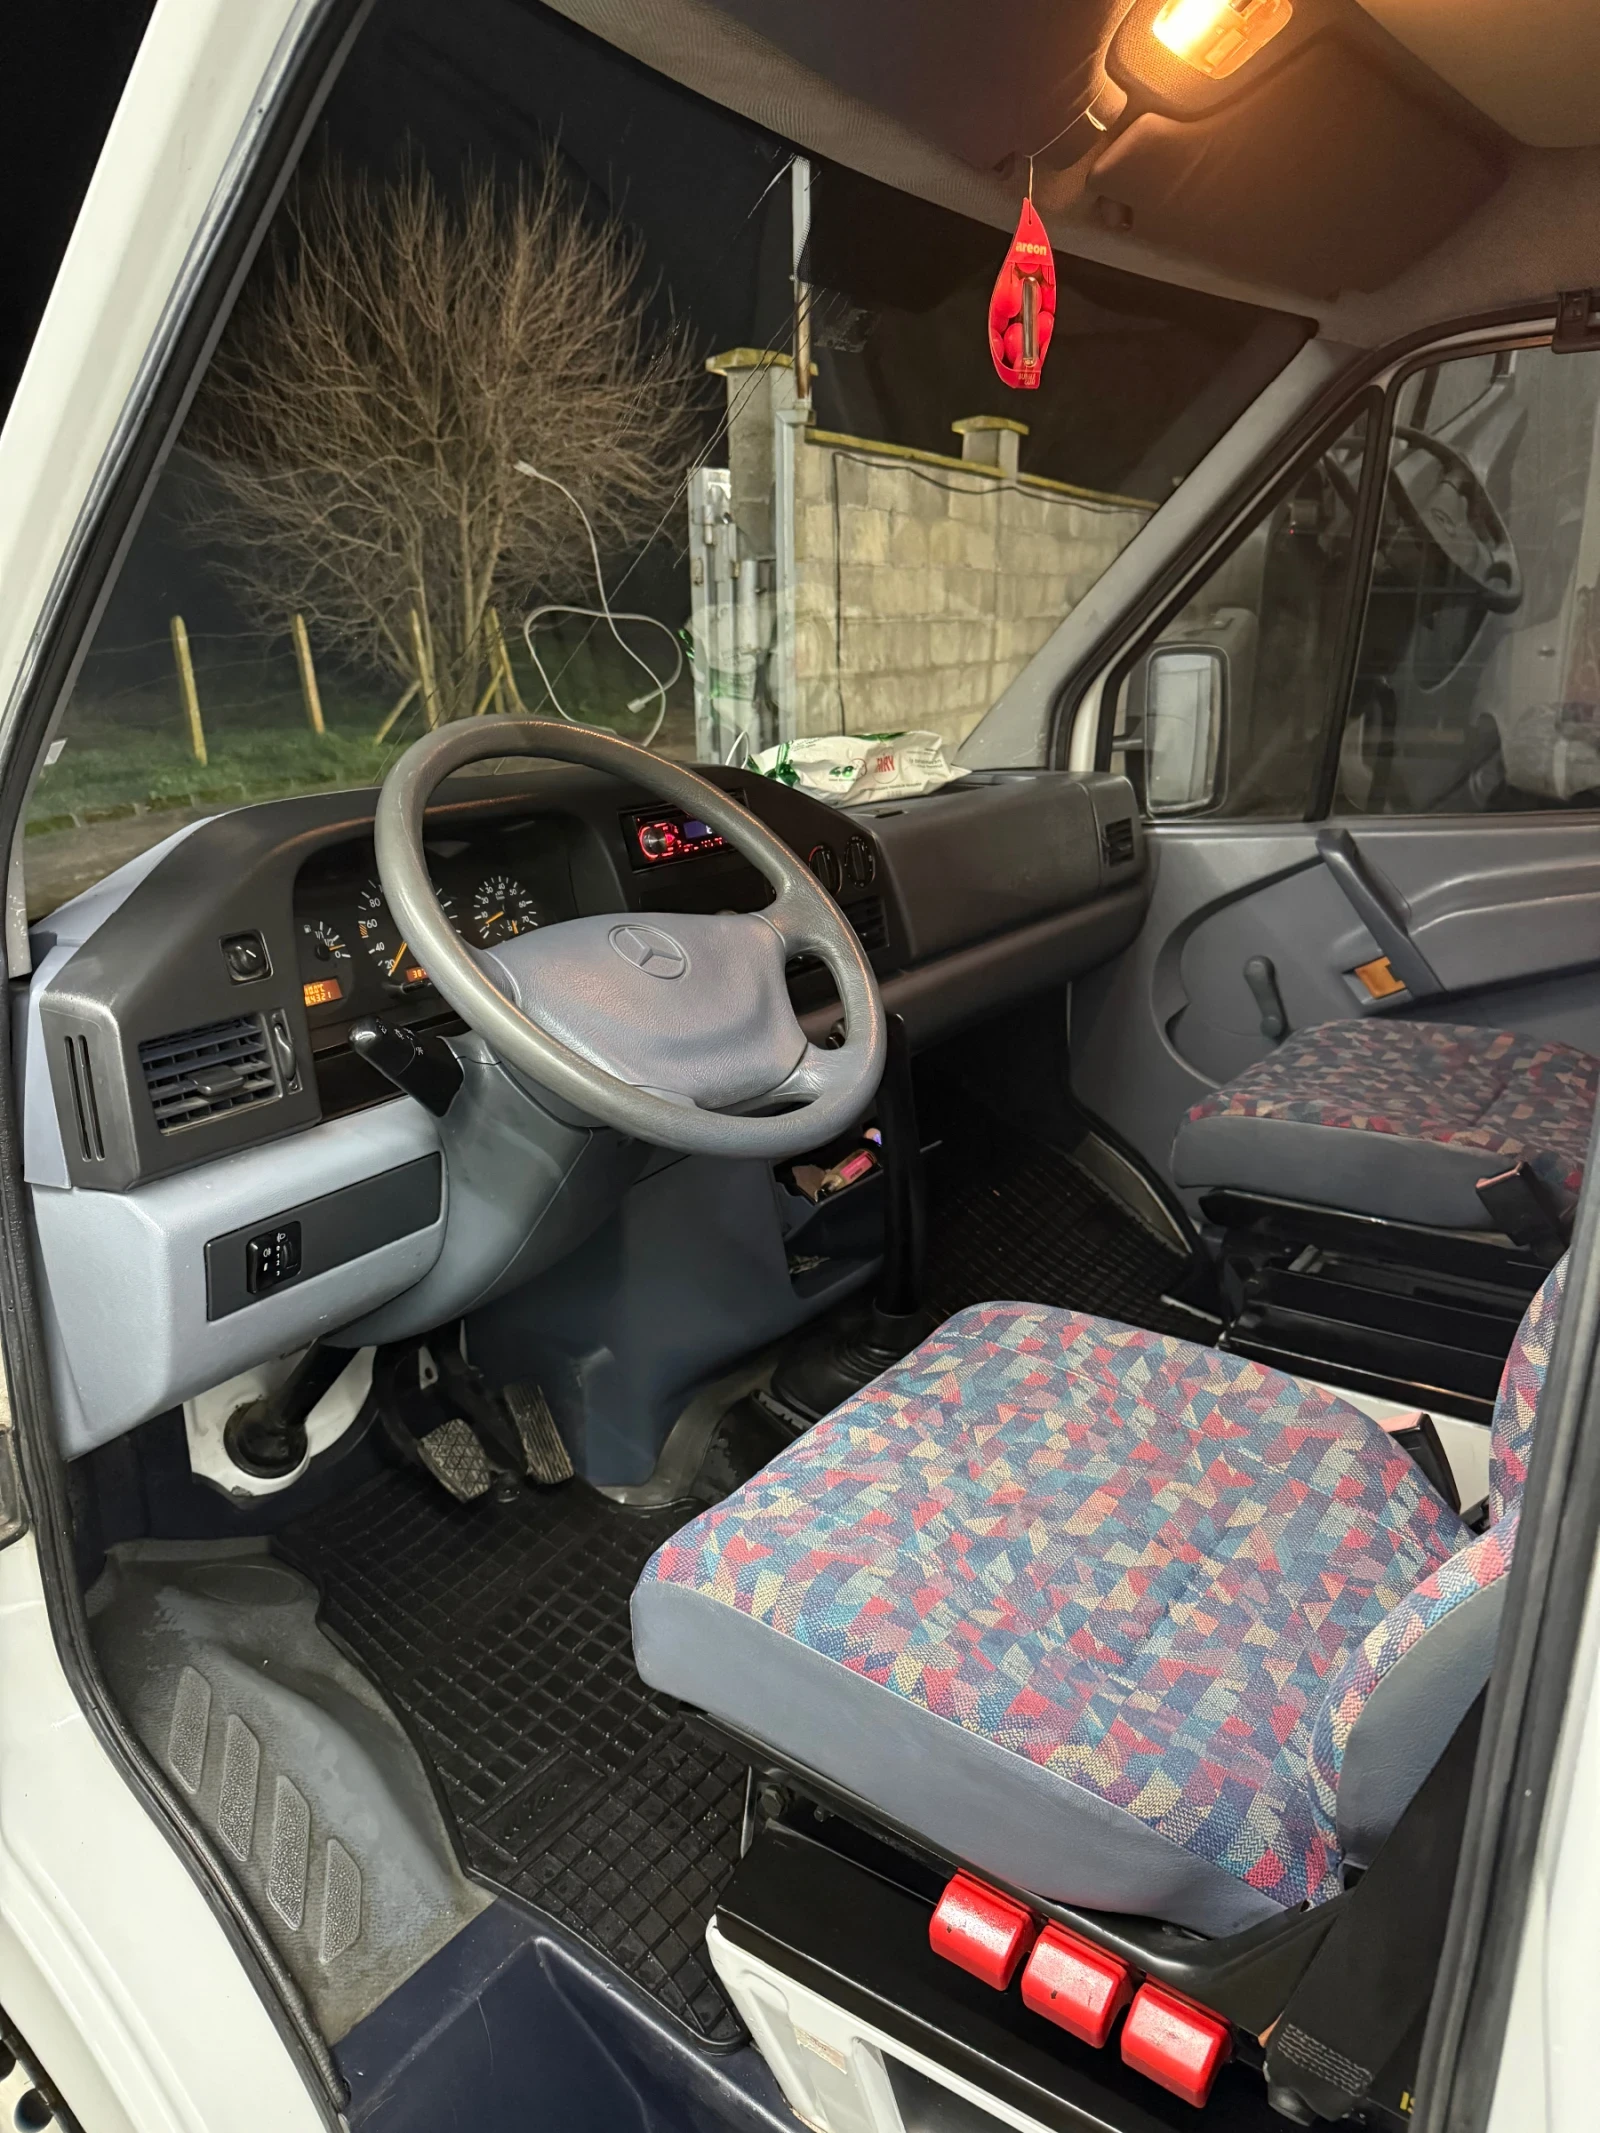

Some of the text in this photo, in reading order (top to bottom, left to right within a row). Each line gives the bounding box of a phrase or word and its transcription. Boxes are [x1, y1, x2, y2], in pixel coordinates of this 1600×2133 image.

[1015, 241, 1047, 256] areon
[369, 897, 381, 908] 80
[366, 918, 378, 929] 60
[375, 941, 385, 951] 40
[334, 950, 341, 959] 0
[384, 958, 395, 970] 20
